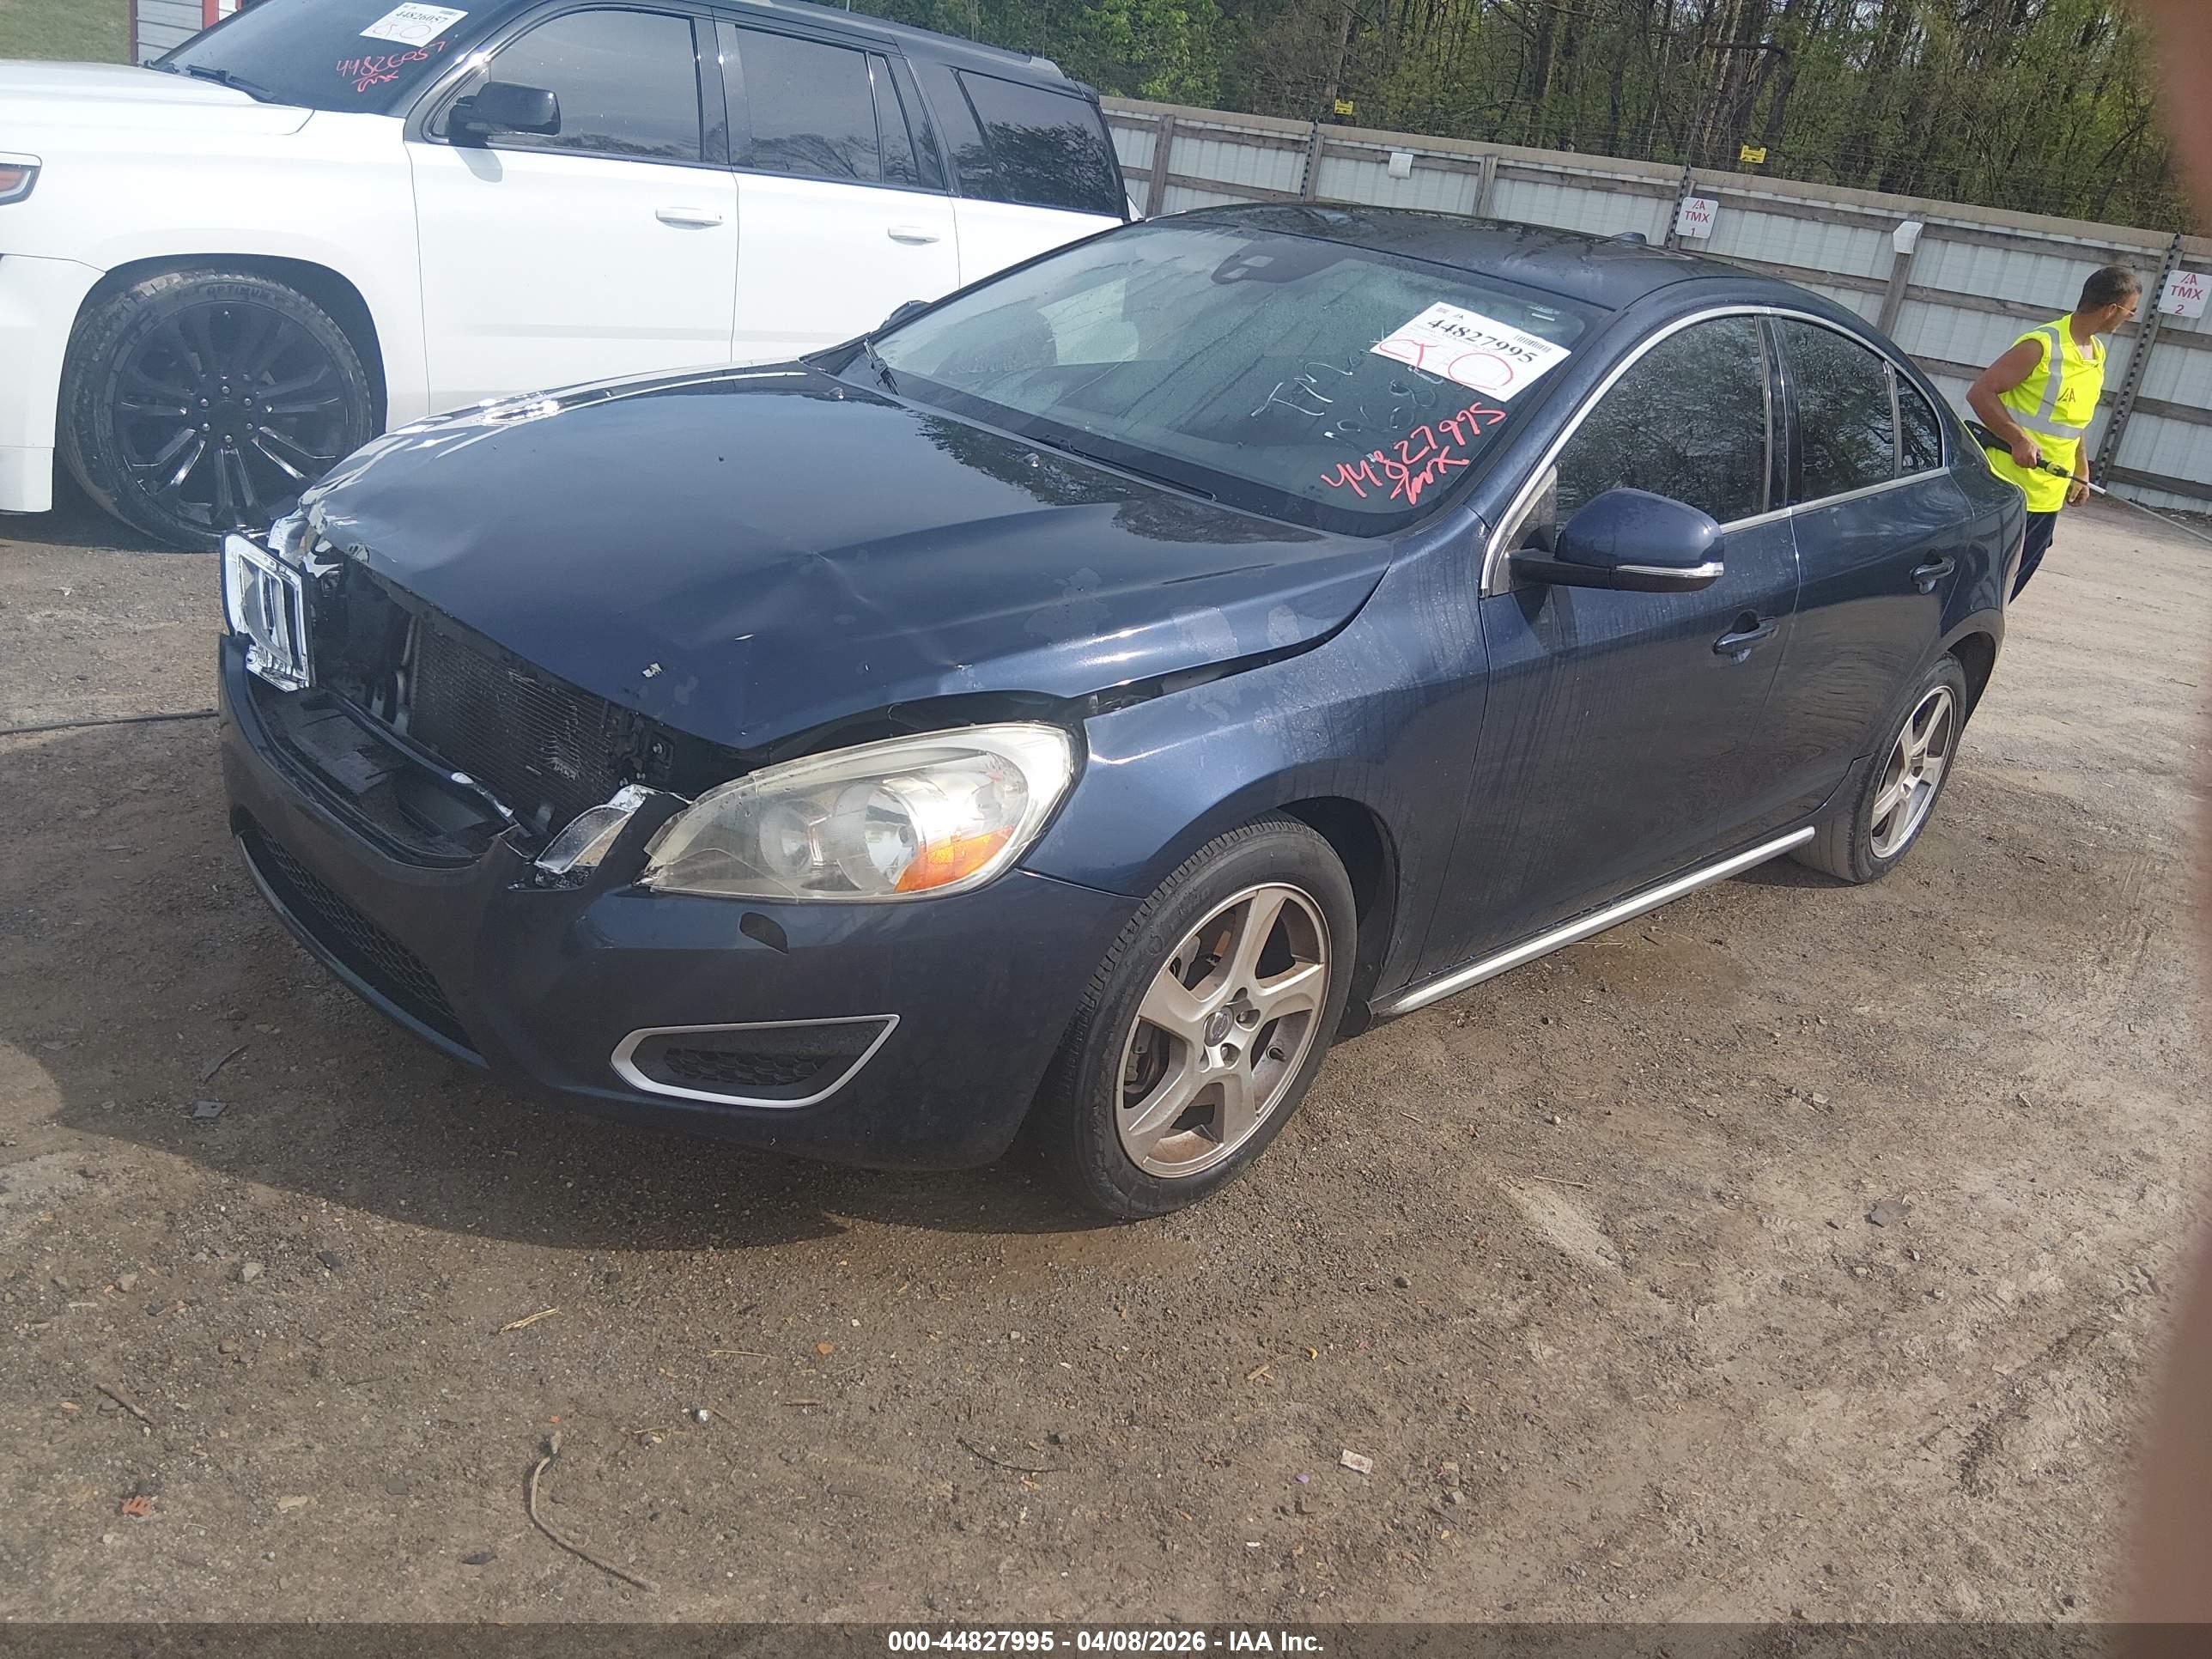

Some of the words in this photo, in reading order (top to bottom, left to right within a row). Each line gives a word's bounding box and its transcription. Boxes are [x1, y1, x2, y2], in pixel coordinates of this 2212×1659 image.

[1685, 210, 1711, 223] TMX
[1691, 227, 1696, 236] 1
[2171, 284, 2203, 301] TMX
[2174, 304, 2185, 315] 2
[1427, 319, 1539, 364] 44827995
[1320, 401, 1506, 498] 44827995
